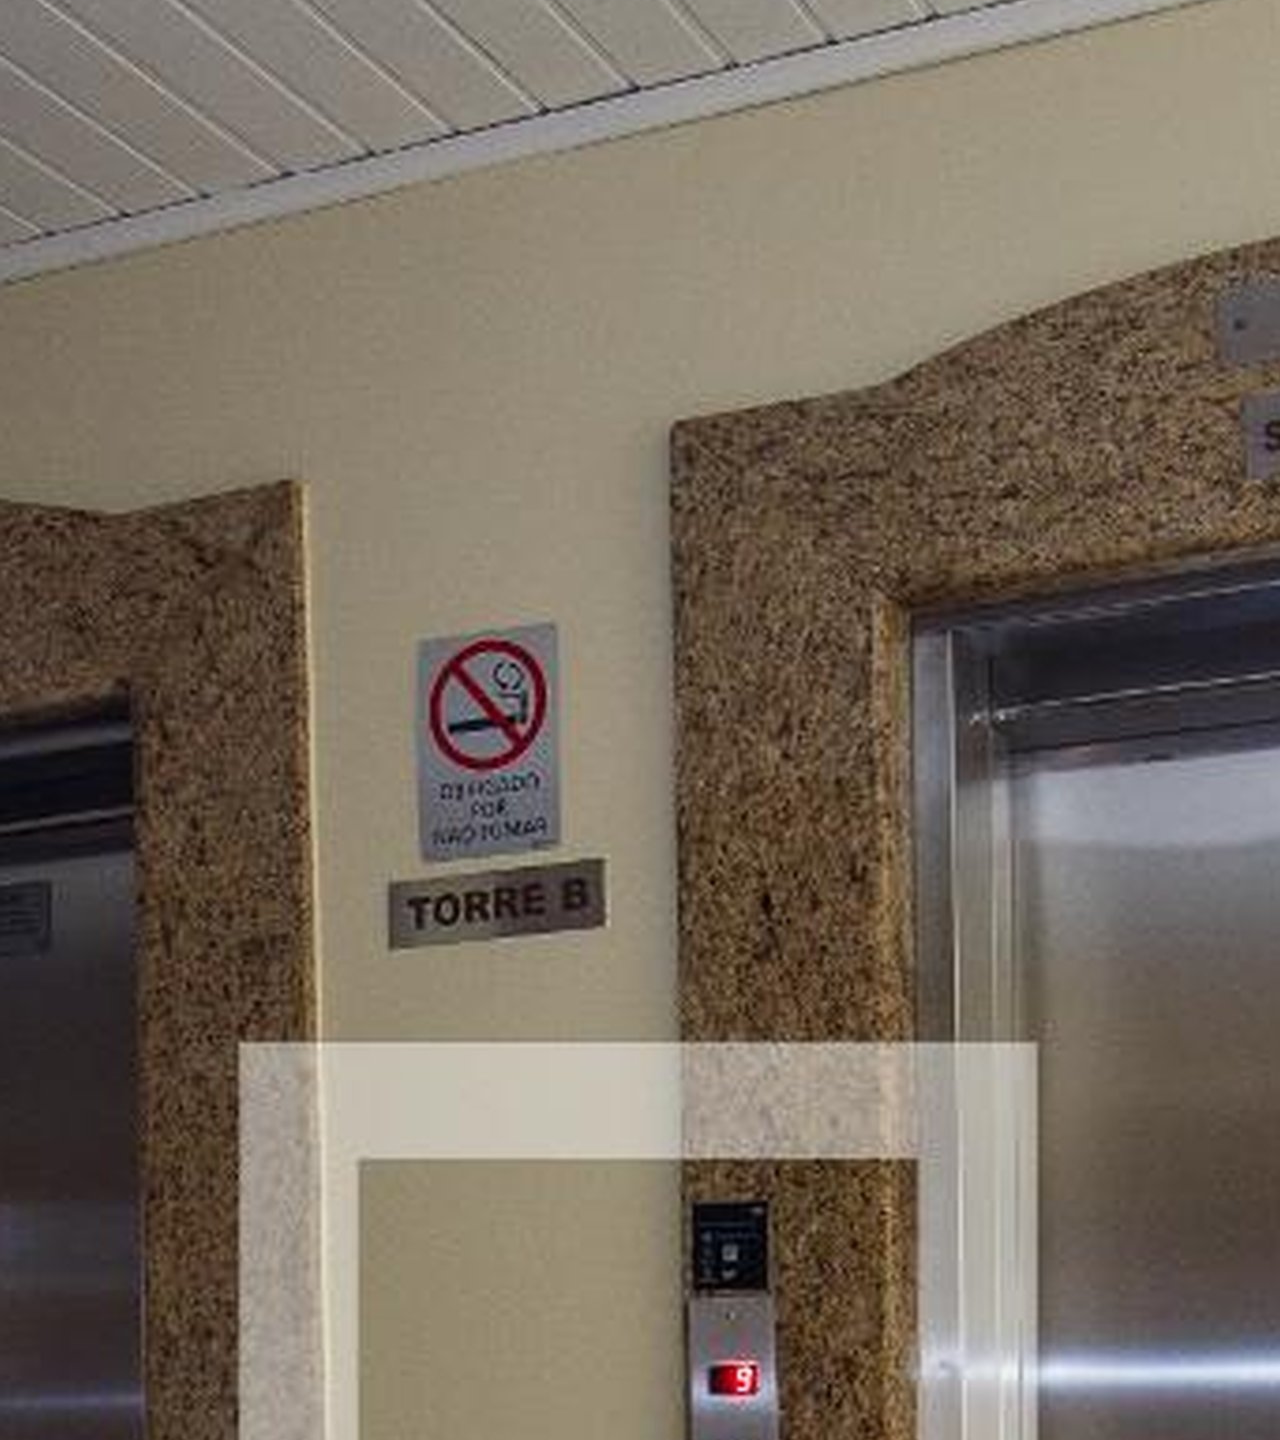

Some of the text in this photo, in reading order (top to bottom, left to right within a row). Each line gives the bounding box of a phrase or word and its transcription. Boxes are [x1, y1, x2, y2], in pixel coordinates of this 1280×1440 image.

[406, 876, 588, 931] TORRE B
[736, 1367, 754, 1393] 9
